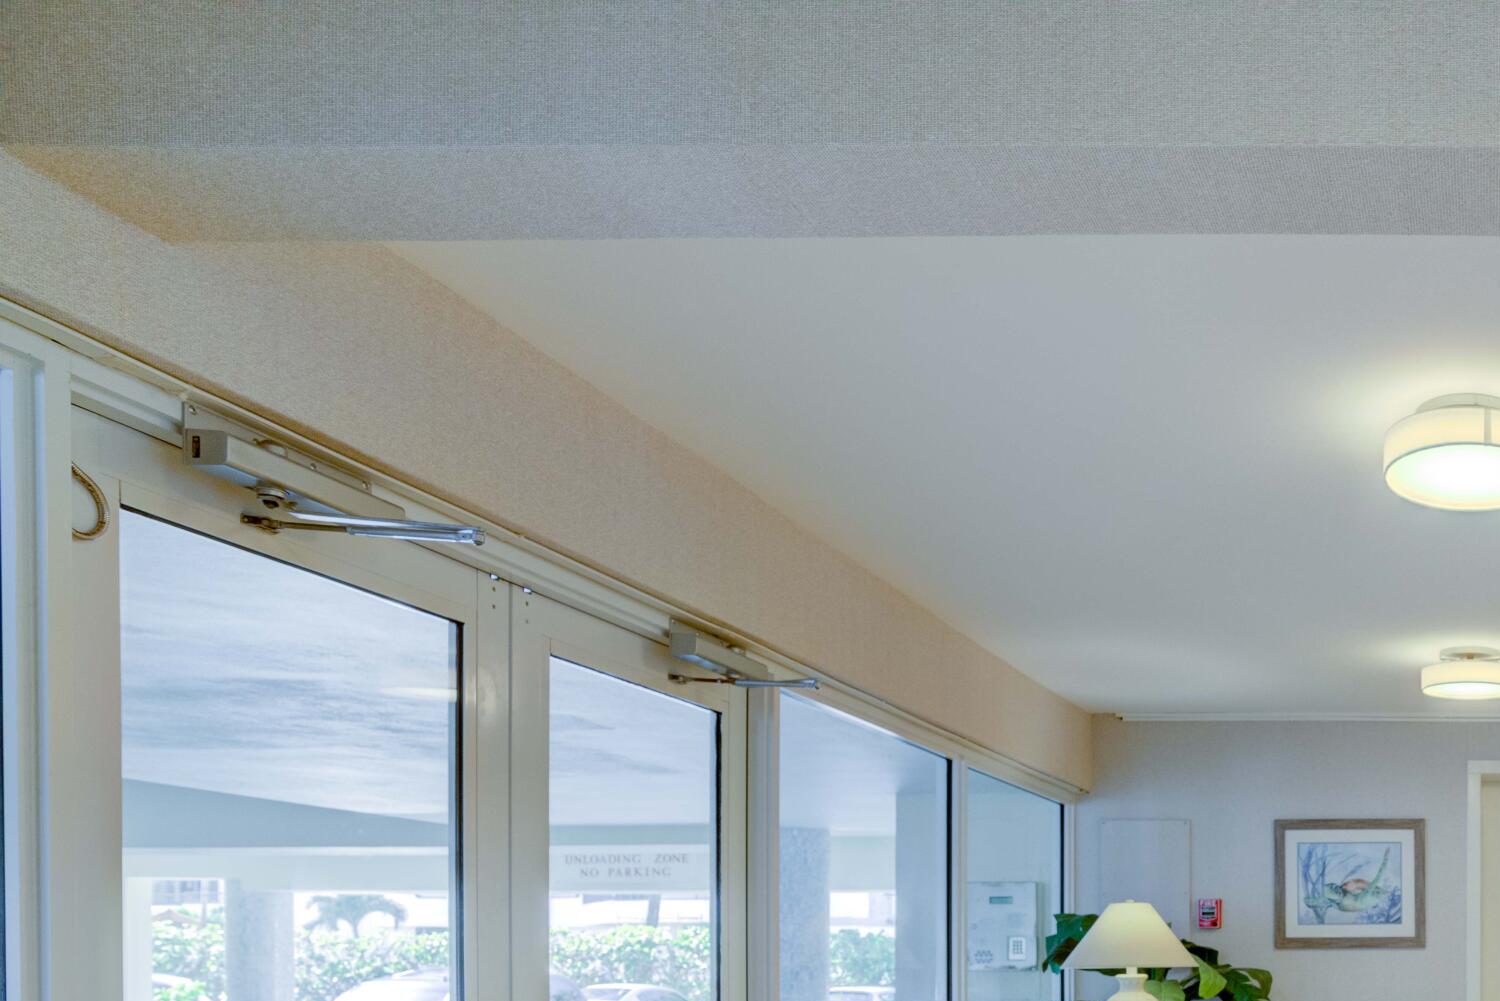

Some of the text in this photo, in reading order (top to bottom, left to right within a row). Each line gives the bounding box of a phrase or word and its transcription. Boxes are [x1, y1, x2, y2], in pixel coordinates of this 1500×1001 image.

[564, 852, 689, 865] UNLOADING ZONE
[579, 866, 672, 878] NO PARKING
